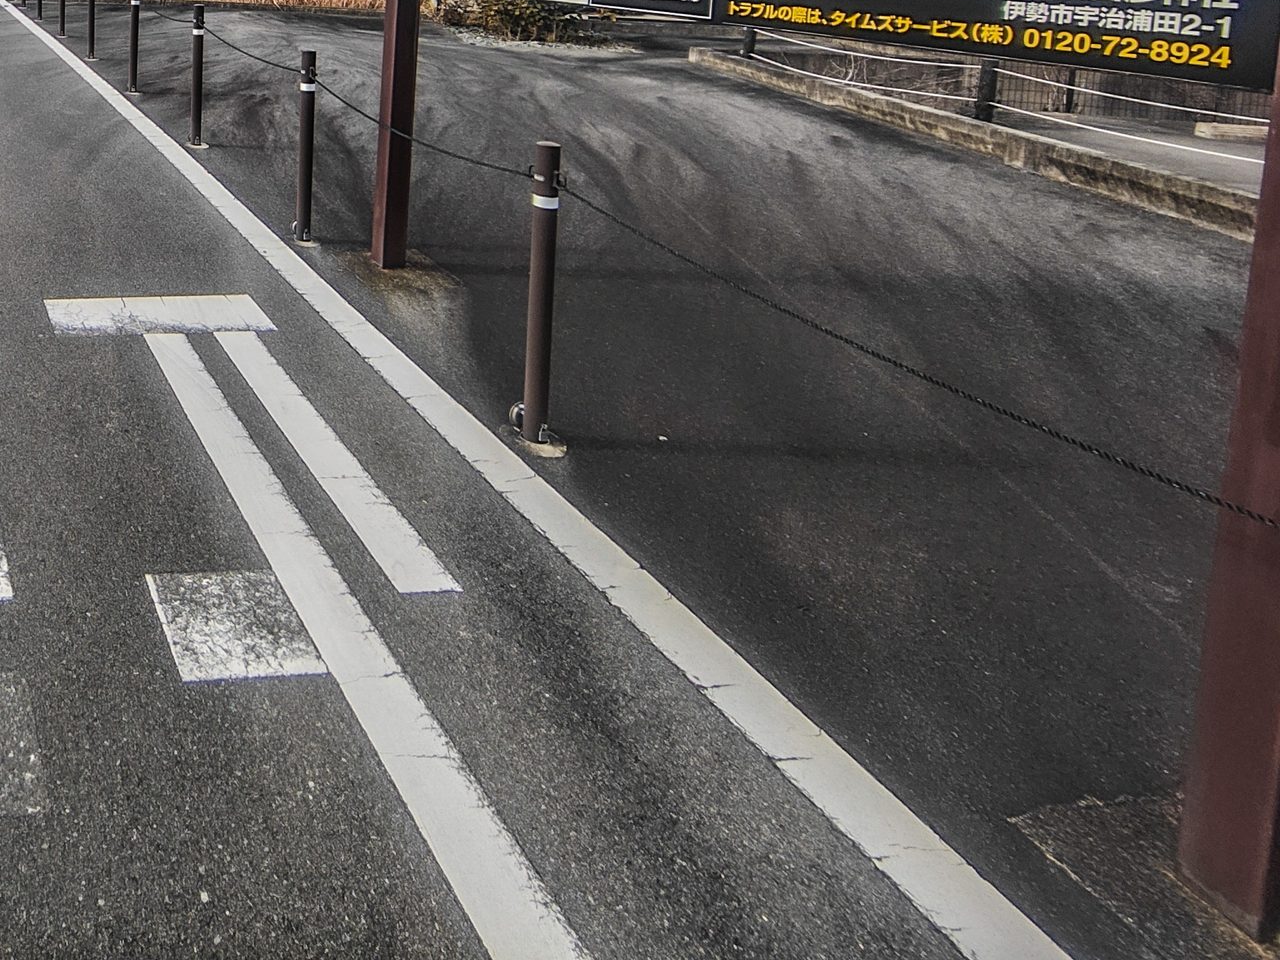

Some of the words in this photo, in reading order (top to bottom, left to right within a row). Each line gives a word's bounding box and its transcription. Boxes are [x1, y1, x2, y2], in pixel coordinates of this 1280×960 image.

[1003, 0, 1233, 39] 伊勢市宇治浦田2-1
[1023, 27, 1232, 69] 0120-72-8924
